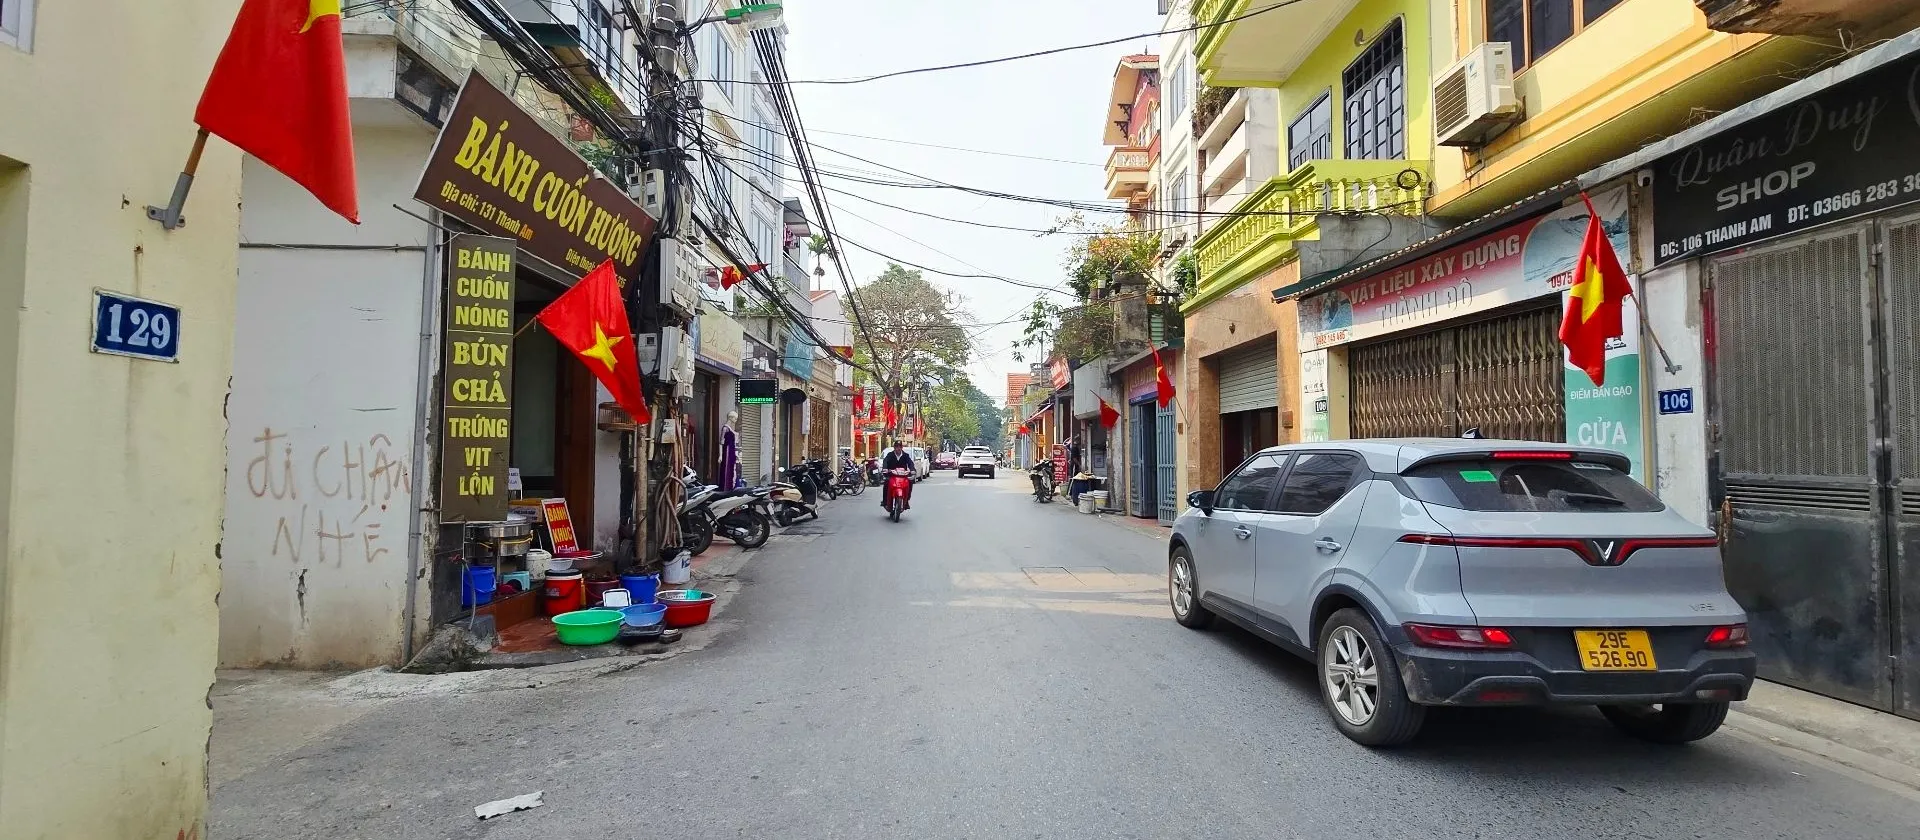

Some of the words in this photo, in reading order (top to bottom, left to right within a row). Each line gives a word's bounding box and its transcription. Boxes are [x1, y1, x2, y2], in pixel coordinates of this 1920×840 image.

[454, 116, 539, 202] BÁNH
[532, 174, 593, 237] CUỐN
[584, 207, 642, 266] HƯƠNG
[1716, 161, 1816, 211] SHOP
[441, 180, 459, 206] Địa
[460, 193, 479, 213] chỉ:
[479, 201, 496, 221] 131
[496, 210, 521, 234] Thanh
[519, 224, 534, 241] Am
[1660, 242, 1679, 258] ĐC:
[1681, 234, 1702, 252] 106
[1705, 220, 1747, 244] THANH
[1750, 213, 1772, 234] AM
[1787, 204, 1809, 224] ĐT:
[1813, 190, 1861, 218] 03666
[1866, 179, 1898, 203] 283
[457, 248, 511, 273] BÁNH
[1351, 285, 1377, 306] VẬT
[1381, 267, 1415, 294] LIỆU
[1421, 256, 1457, 283] XÂY
[1461, 233, 1520, 270] DỰNG
[456, 273, 509, 300] CUỐN
[1551, 271, 1573, 289] 0975
[107, 303, 171, 349] 129
[455, 303, 509, 328] NÓNG
[452, 337, 508, 367] BÚN
[452, 371, 506, 403] CHẢ
[1663, 393, 1689, 410] 106
[449, 413, 508, 438] TRỨNG
[1577, 417, 1628, 445] CỬA
[465, 447, 491, 471] VỊT
[547, 505, 569, 522] BÁNH
[1598, 630, 1631, 649] 29E
[1589, 650, 1648, 669] 526.90
